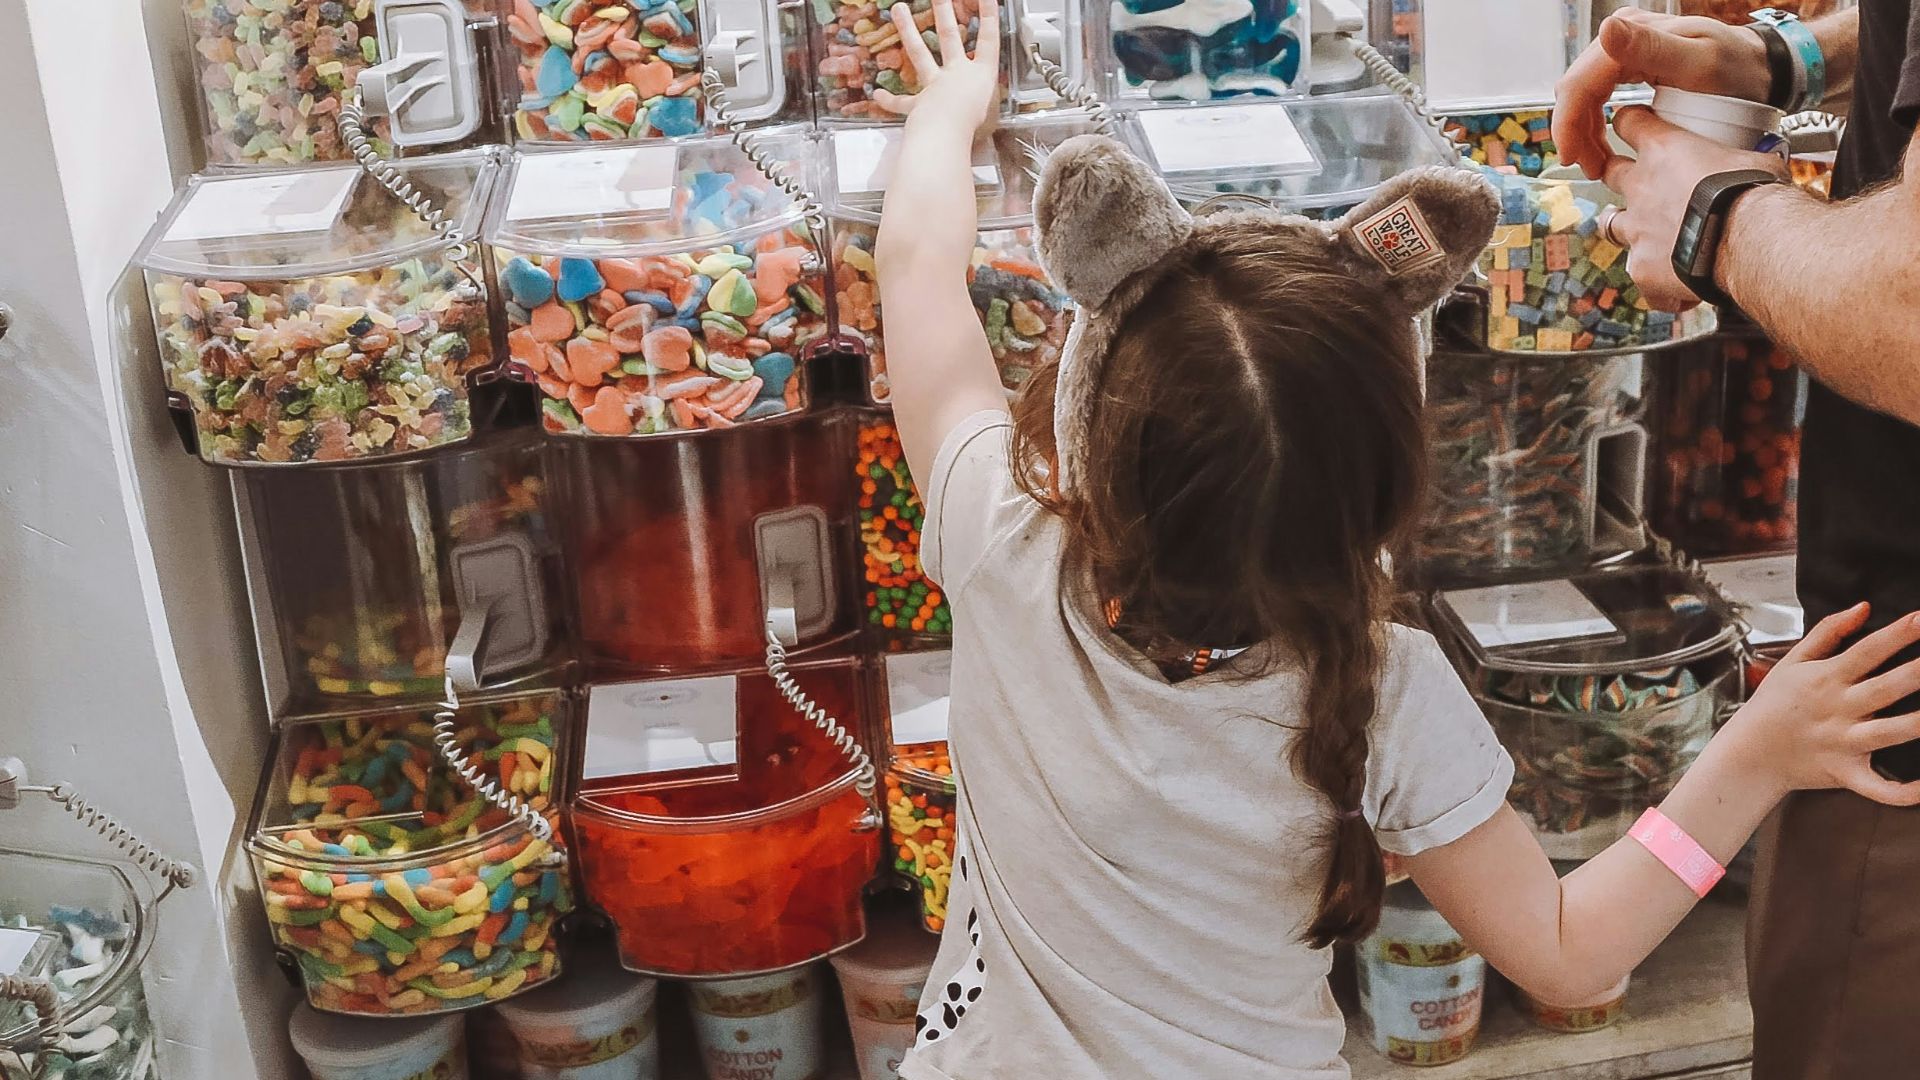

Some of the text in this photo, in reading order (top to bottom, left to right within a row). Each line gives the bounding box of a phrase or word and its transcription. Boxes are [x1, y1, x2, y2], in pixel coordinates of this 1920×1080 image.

[1391, 212, 1426, 252] GREAT
[1410, 987, 1480, 1014] COTTON
[707, 1047, 784, 1066] COTTON
